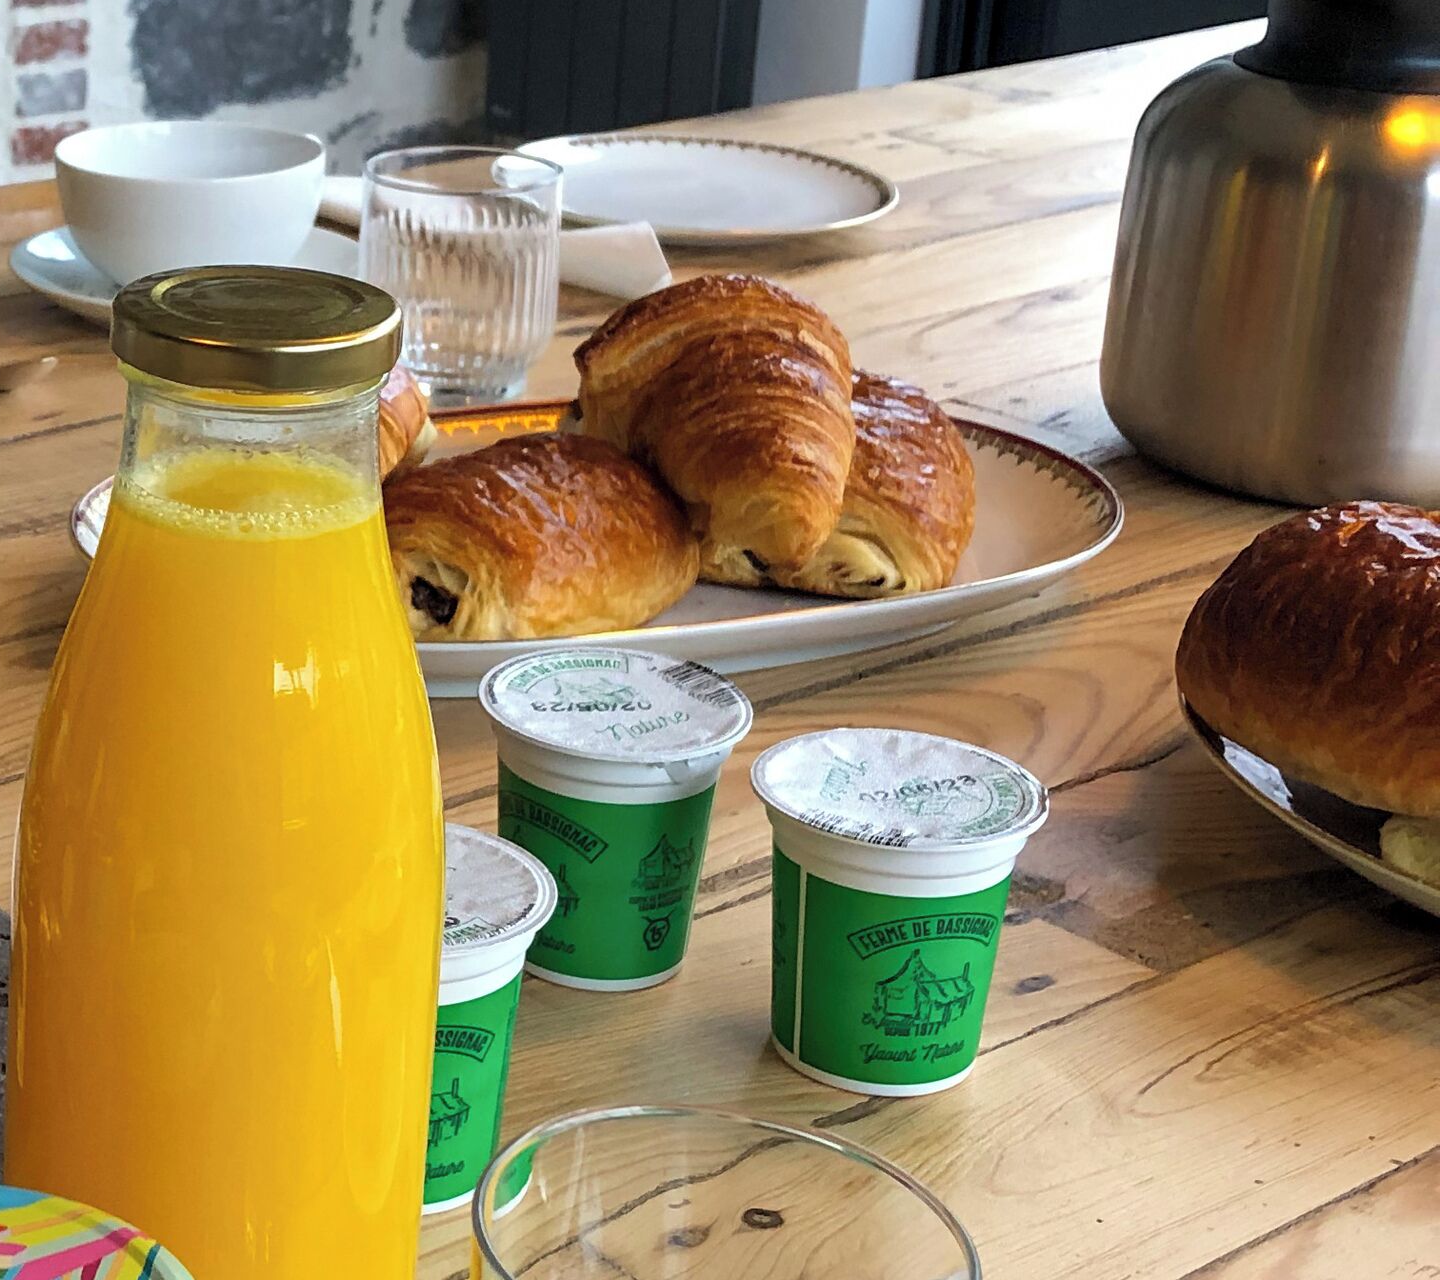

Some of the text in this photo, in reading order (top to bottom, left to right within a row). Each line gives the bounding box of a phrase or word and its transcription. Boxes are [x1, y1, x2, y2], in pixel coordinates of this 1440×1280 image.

[594, 710, 691, 742] Nature
[528, 803, 600, 853] BASSIGNAC
[858, 923, 907, 950] FERME
[912, 920, 932, 938] DE
[435, 1029, 489, 1053] SSIGNAC
[914, 1021, 942, 1037] 1977
[859, 1042, 918, 1064] Yaourt
